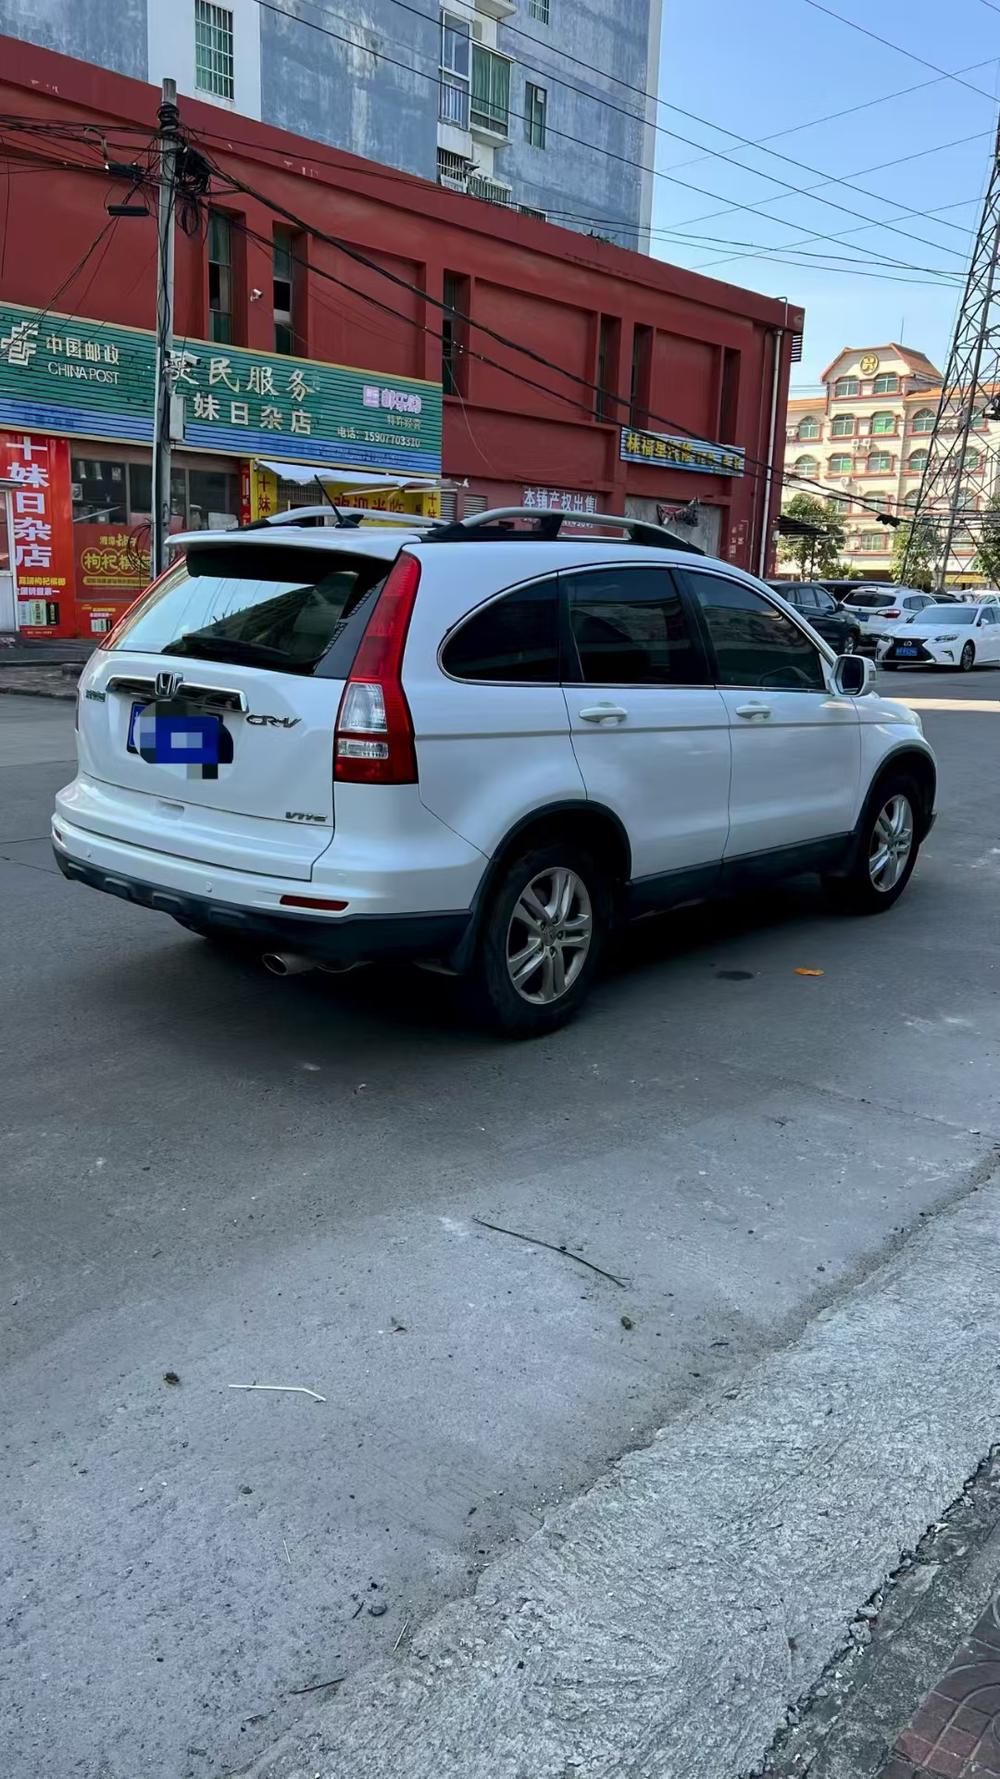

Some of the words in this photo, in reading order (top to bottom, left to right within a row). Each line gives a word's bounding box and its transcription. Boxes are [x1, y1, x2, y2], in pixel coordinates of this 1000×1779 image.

[46, 334, 120, 365] 中国邮政
[48, 362, 88, 380] CHINA
[89, 369, 120, 385] POST
[174, 386, 312, 435] 妹日杂店
[5, 436, 52, 568] 十妹日杂店
[258, 474, 271, 518] 十妹
